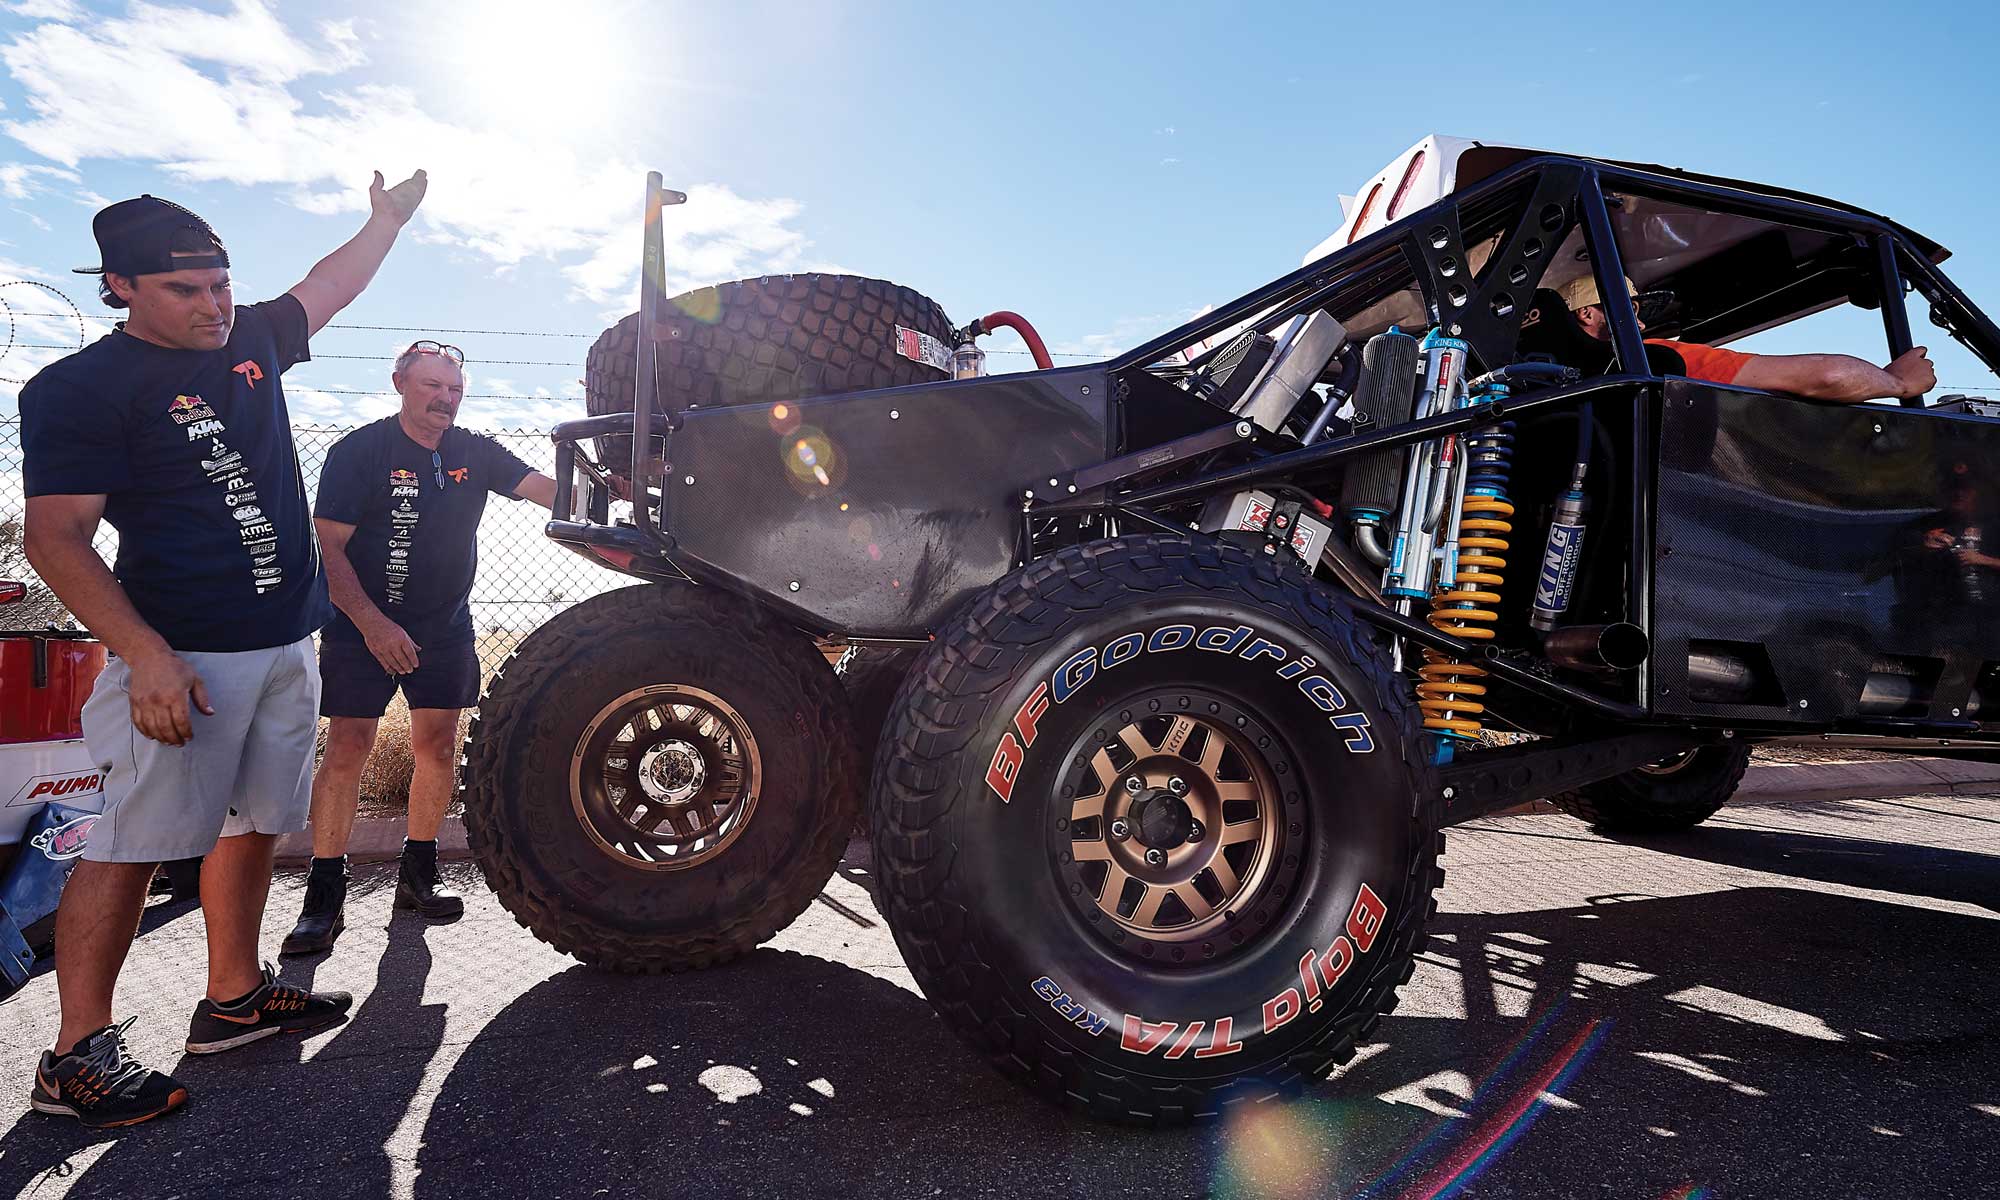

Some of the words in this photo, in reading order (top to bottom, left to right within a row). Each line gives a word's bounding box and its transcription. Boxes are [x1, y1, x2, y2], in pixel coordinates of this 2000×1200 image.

[187, 418, 226, 438] KTM
[239, 523, 274, 537] KMC
[1537, 527, 1568, 606] KING
[1557, 545, 1575, 596] OFF-ROAD
[1561, 569, 1575, 607] RACING
[1570, 530, 1584, 568] SHOCKS
[984, 624, 1376, 804] BFGoodrich
[1167, 720, 1189, 753] KMC
[26, 774, 100, 800] PUMA
[1261, 882, 1389, 1035] Baja
[1031, 975, 1110, 1037] KR3
[1120, 1013, 1243, 1060] T/A
